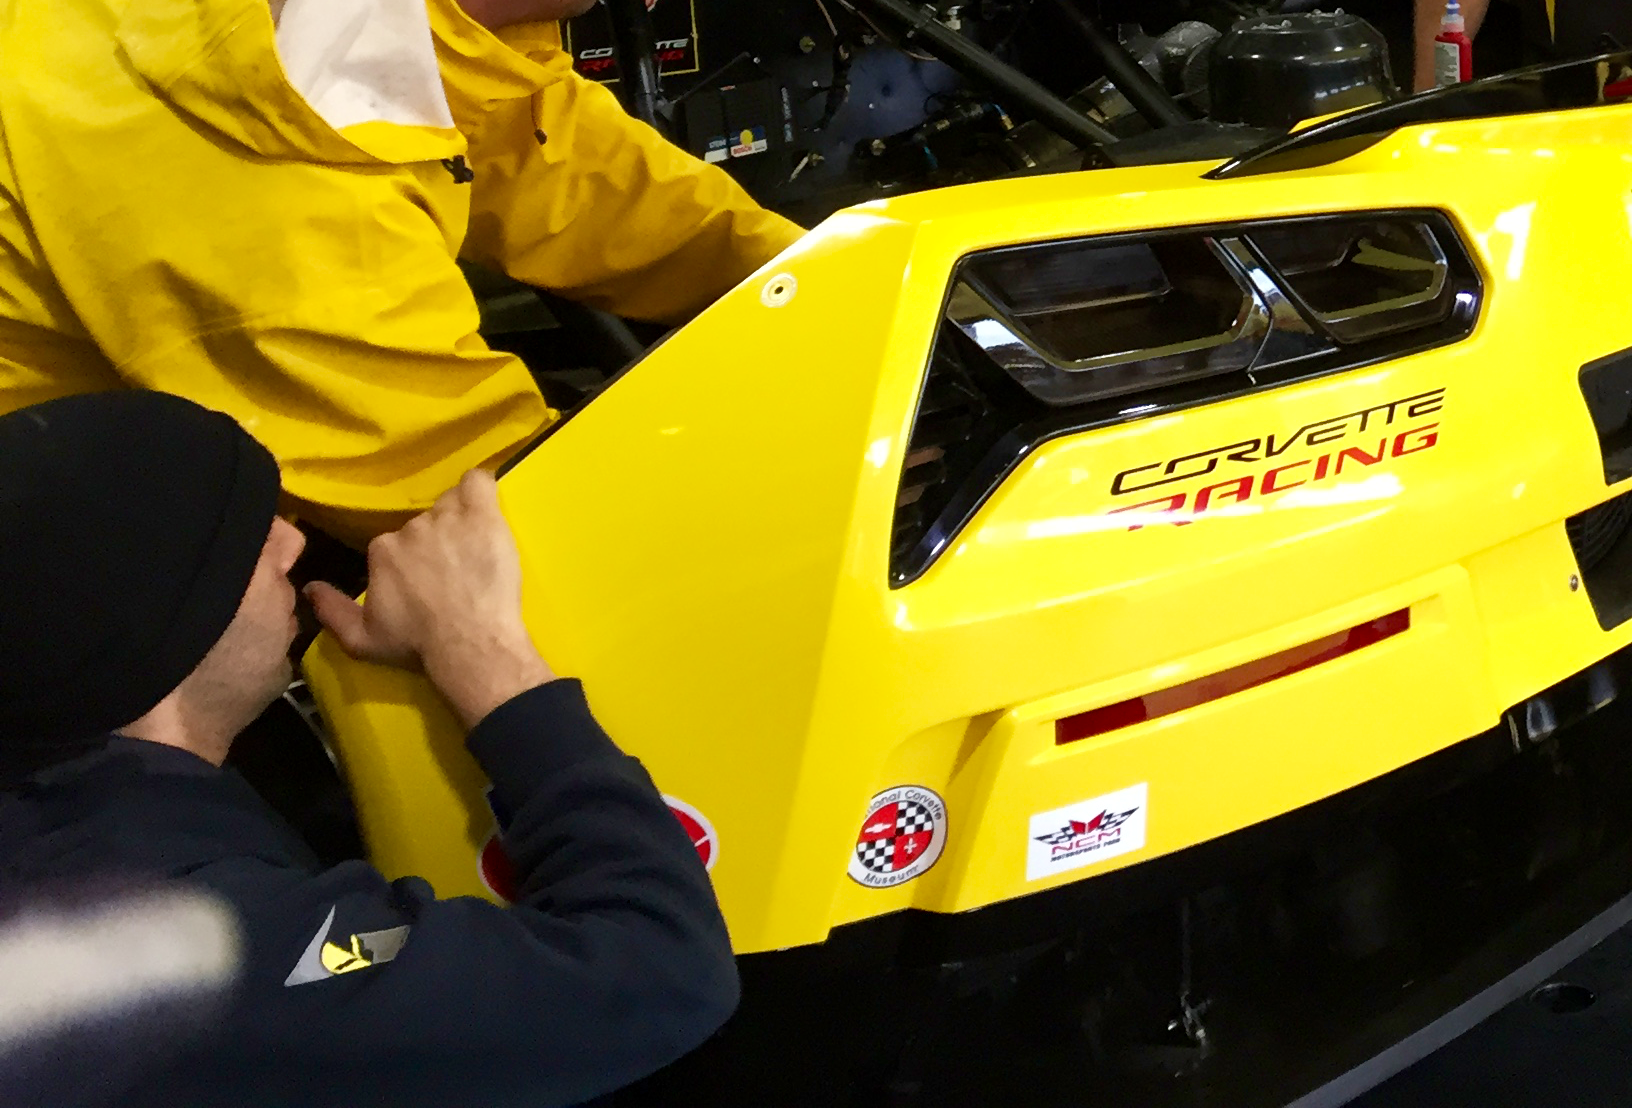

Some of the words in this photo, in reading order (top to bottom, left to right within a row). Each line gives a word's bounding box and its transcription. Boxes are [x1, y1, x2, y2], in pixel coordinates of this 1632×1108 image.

[579, 37, 689, 60] COTTE
[1110, 387, 1447, 497] CORVETTE
[1105, 421, 1441, 533] RACING
[904, 789, 942, 821] Corvette
[1051, 827, 1122, 856] NCM
[863, 864, 919, 886] Museum
